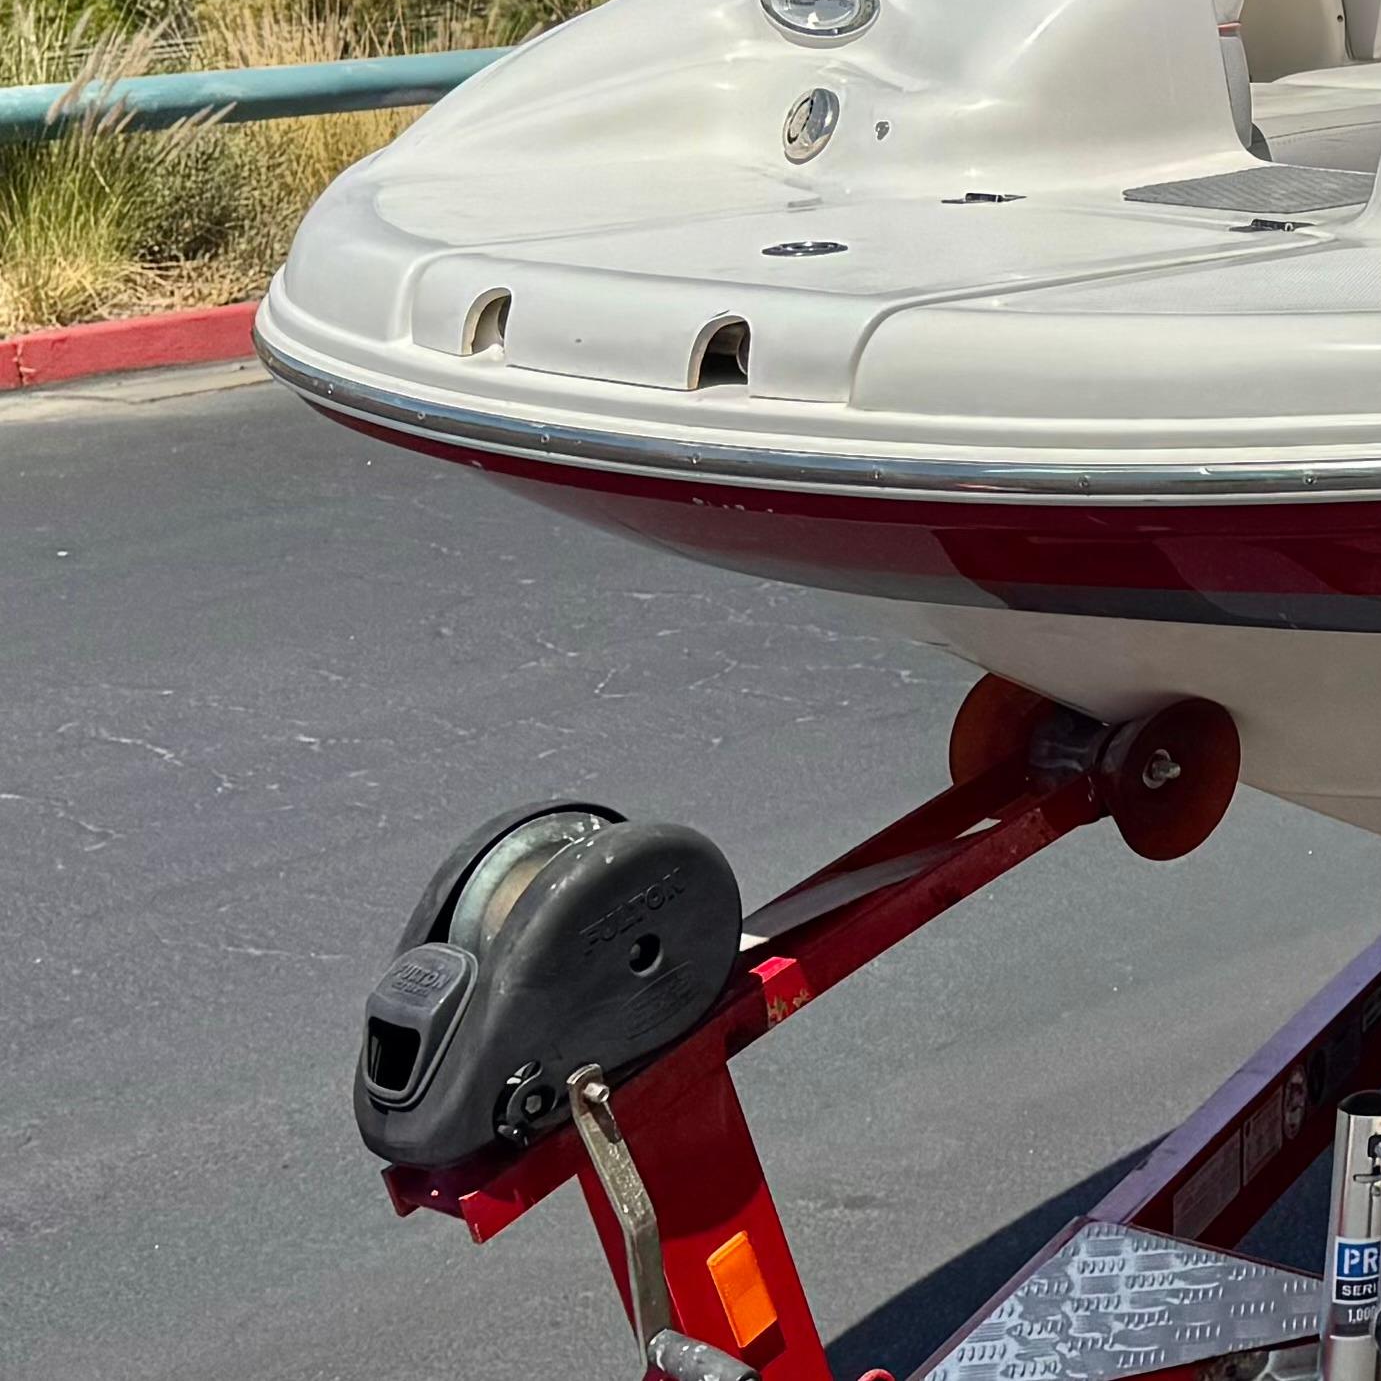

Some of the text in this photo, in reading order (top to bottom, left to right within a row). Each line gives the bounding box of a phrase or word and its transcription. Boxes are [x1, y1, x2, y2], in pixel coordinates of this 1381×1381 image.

[579, 866, 686, 957] FULTON
[1343, 1247, 1379, 1275] PR
[1341, 1282, 1377, 1297] SERI
